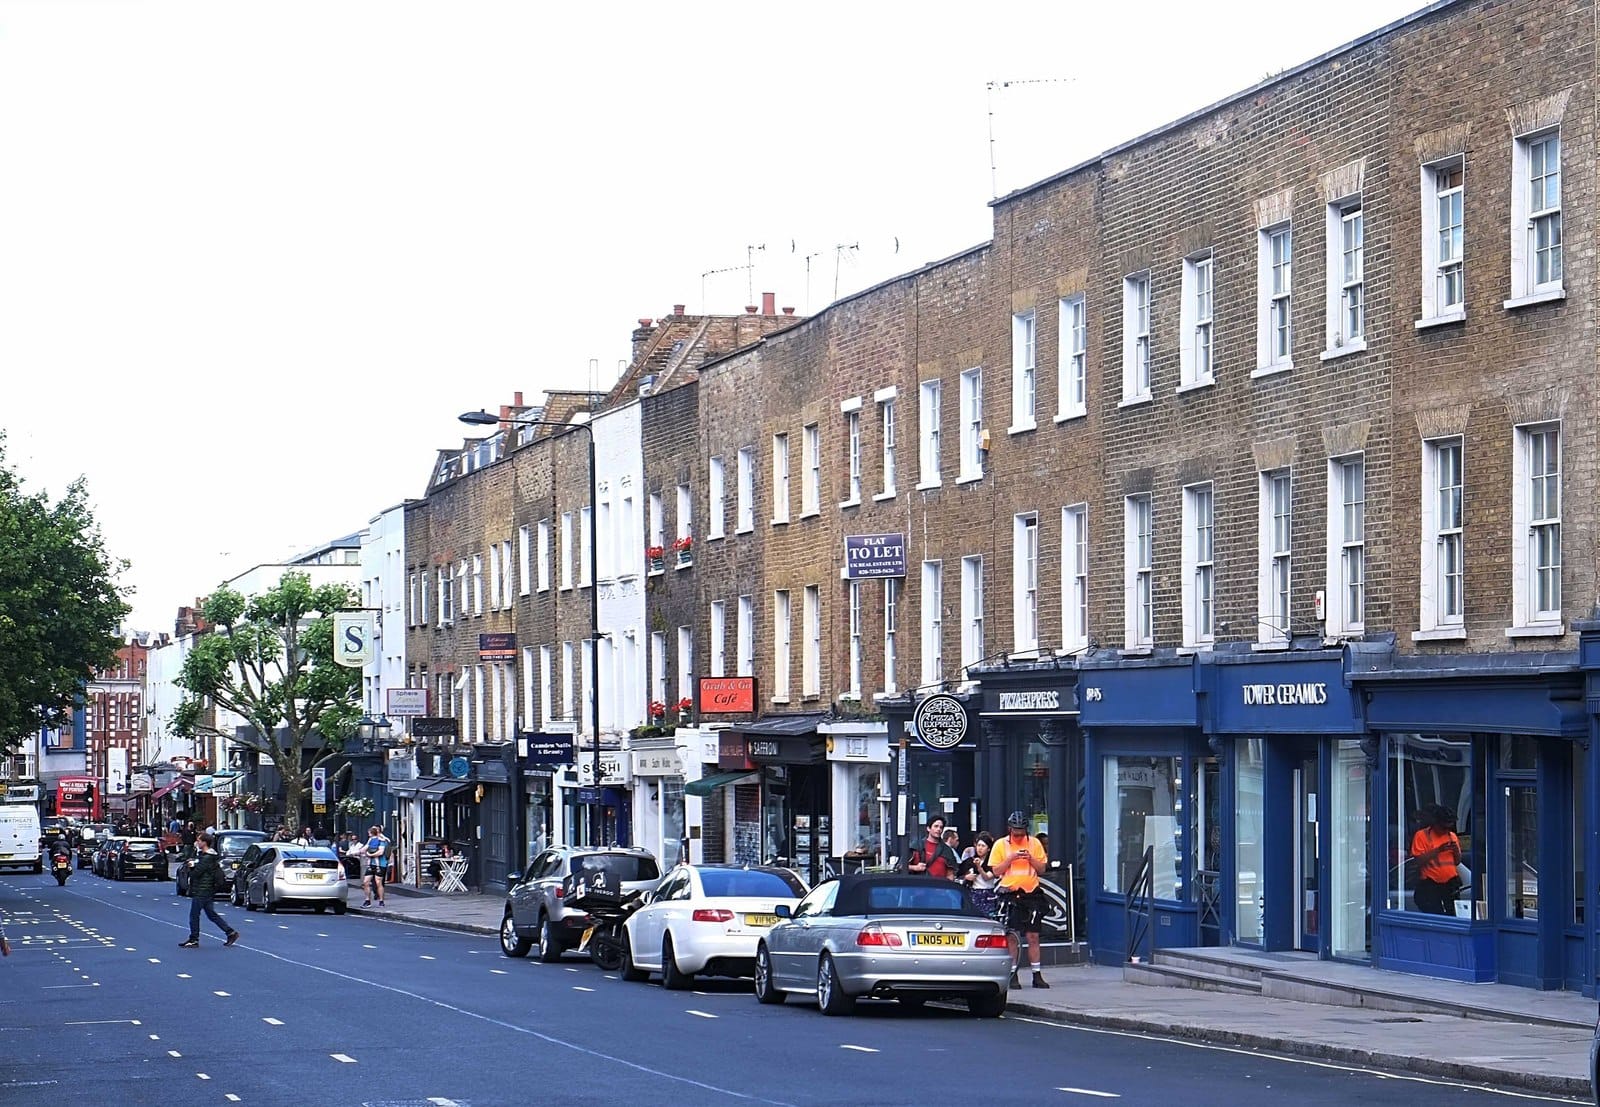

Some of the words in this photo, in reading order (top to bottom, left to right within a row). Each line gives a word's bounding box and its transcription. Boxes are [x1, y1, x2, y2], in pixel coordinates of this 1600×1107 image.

[864, 537, 885, 545] FLAT
[849, 547, 870, 559] TO
[874, 545, 902, 558] LET
[344, 625, 364, 653] S
[702, 681, 726, 690] Grab
[728, 681, 736, 690] &
[738, 680, 752, 690] Go
[714, 693, 737, 705] Café
[999, 690, 1059, 710] PIZZAEXPRESS
[1242, 684, 1276, 705] TOWER
[1276, 683, 1327, 704] CERAMICS
[924, 720, 962, 728] EXPRESS
[753, 741, 778, 755] SAFFRON
[583, 762, 621, 774] SSHI
[917, 935, 943, 945] LN05
[945, 935, 964, 945] JVL
